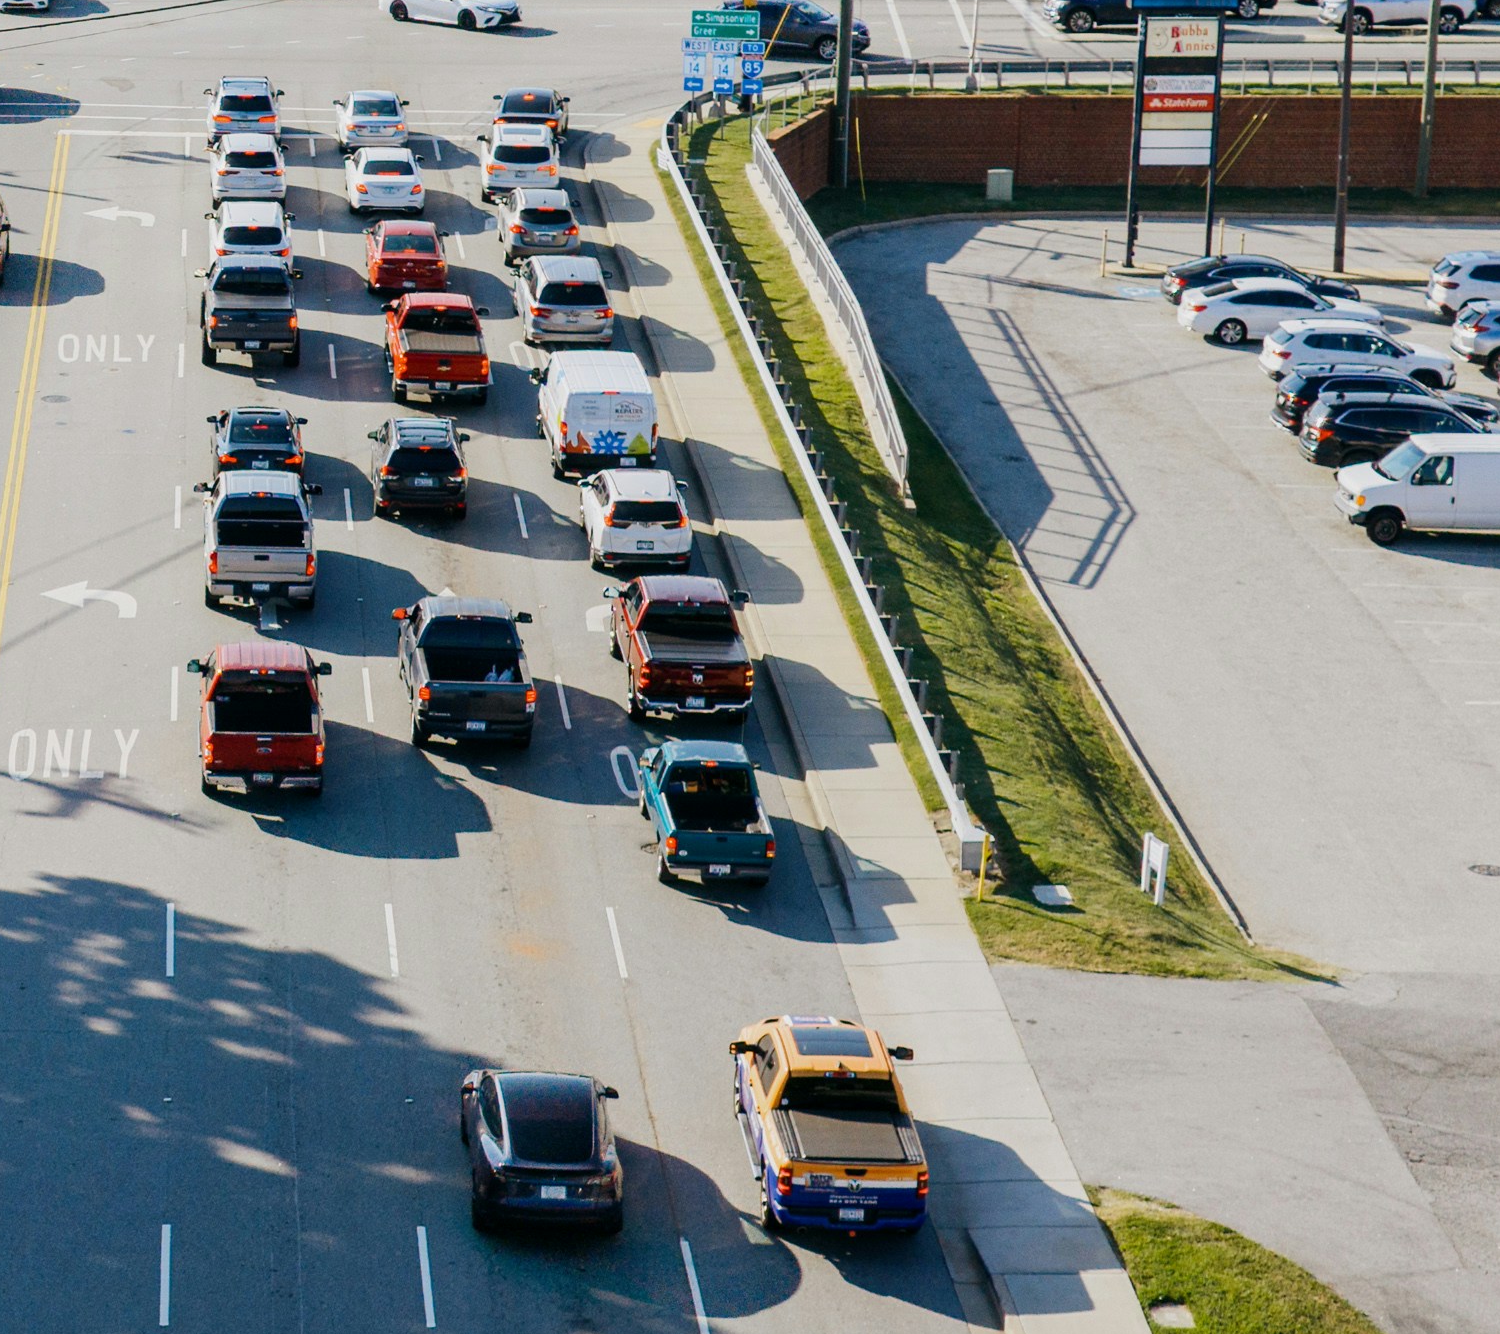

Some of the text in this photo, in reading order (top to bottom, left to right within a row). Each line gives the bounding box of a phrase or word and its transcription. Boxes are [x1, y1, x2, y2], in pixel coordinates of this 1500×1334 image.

[705, 13, 756, 24] Simpsonville
[693, 26, 717, 35] Greer
[1171, 25, 1208, 38] Bubba
[684, 40, 707, 49] WEST
[713, 42, 735, 51] EAST
[689, 63, 699, 73] 14
[718, 64, 729, 74] 14
[744, 62, 761, 74] 85
[58, 333, 156, 364] ONLY
[7, 728, 140, 782] ONLY
